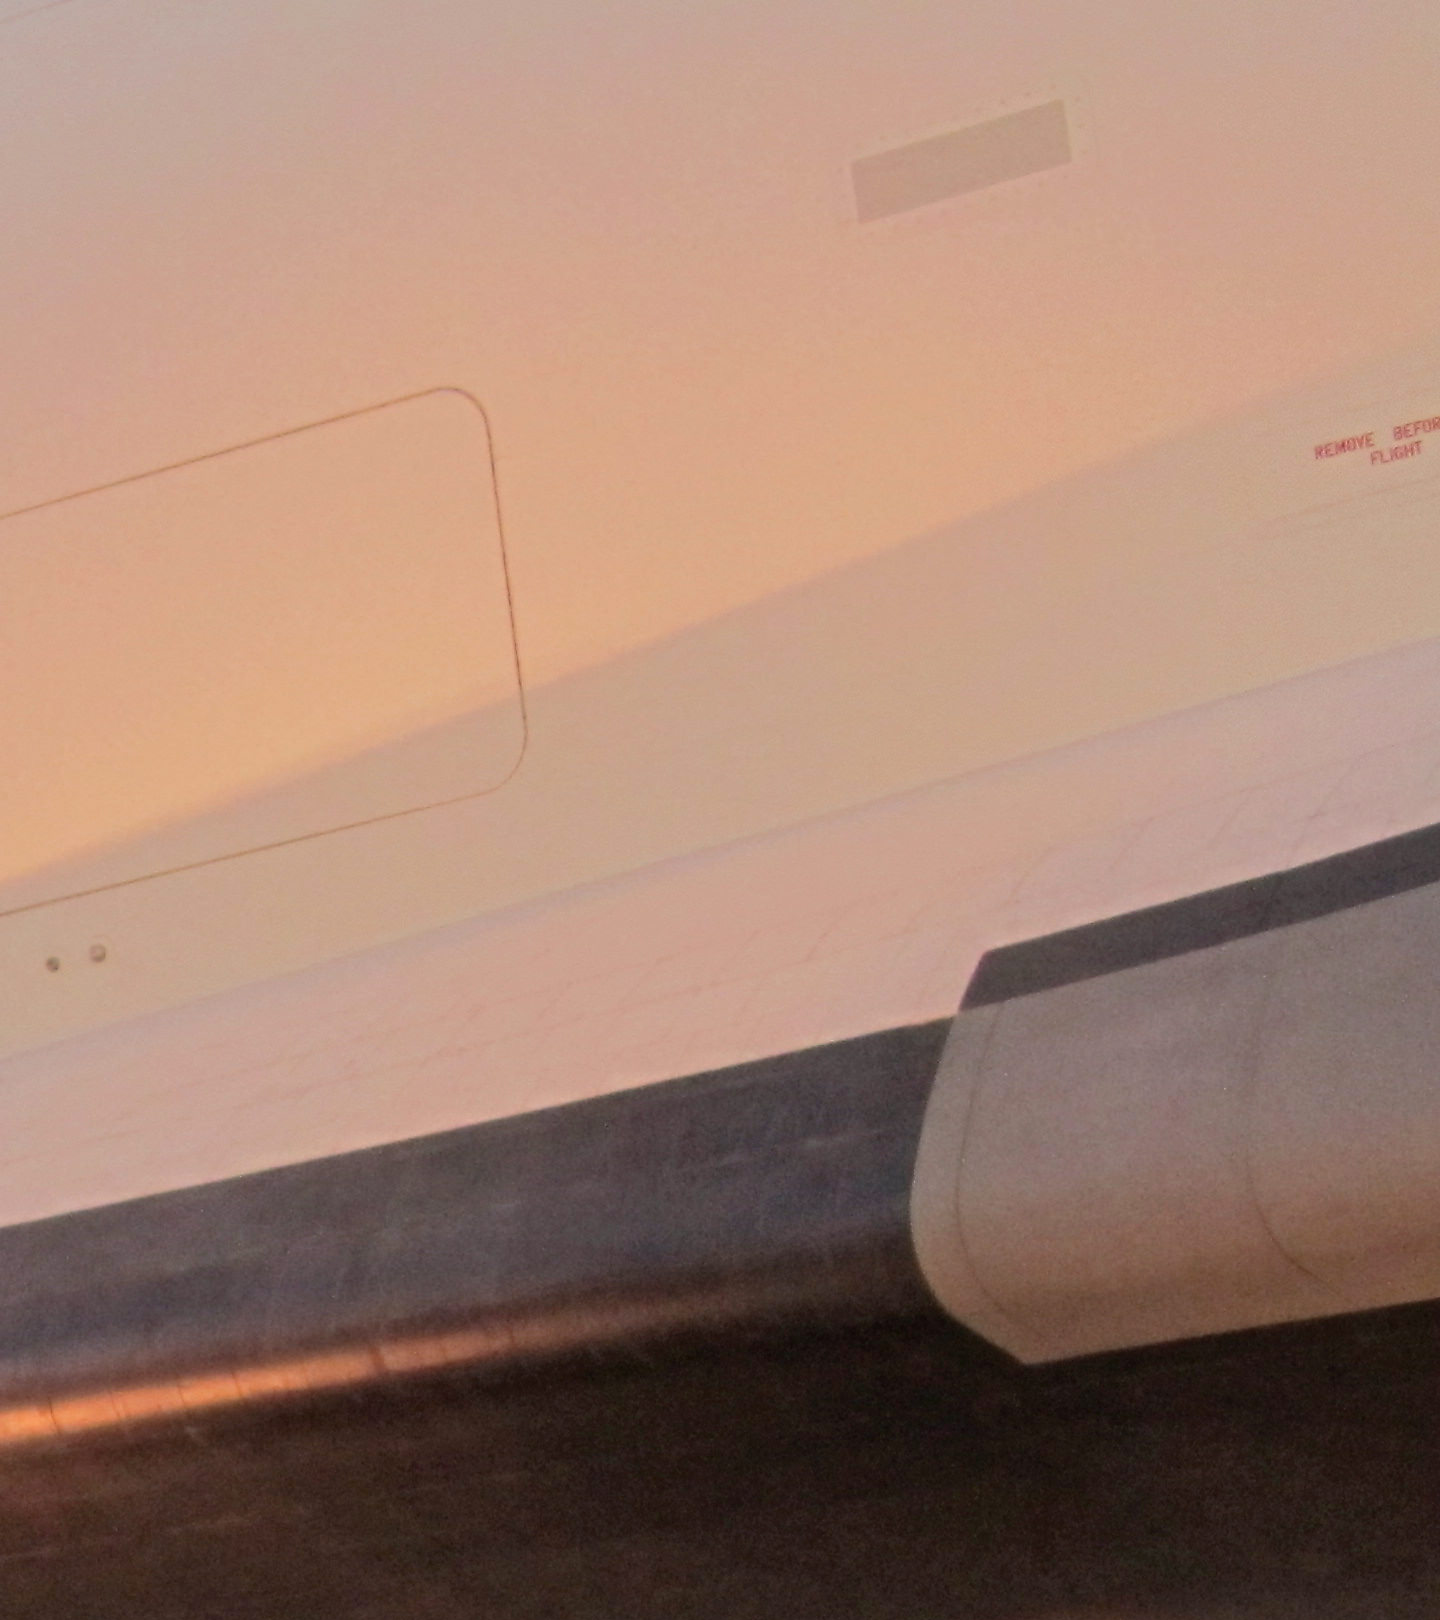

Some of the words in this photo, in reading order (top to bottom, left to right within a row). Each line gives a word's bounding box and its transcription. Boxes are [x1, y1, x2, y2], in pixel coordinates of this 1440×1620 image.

[1314, 432, 1376, 460] REMOVE
[1393, 416, 1440, 441] BEFOR
[1370, 441, 1423, 465] FLIGHT
